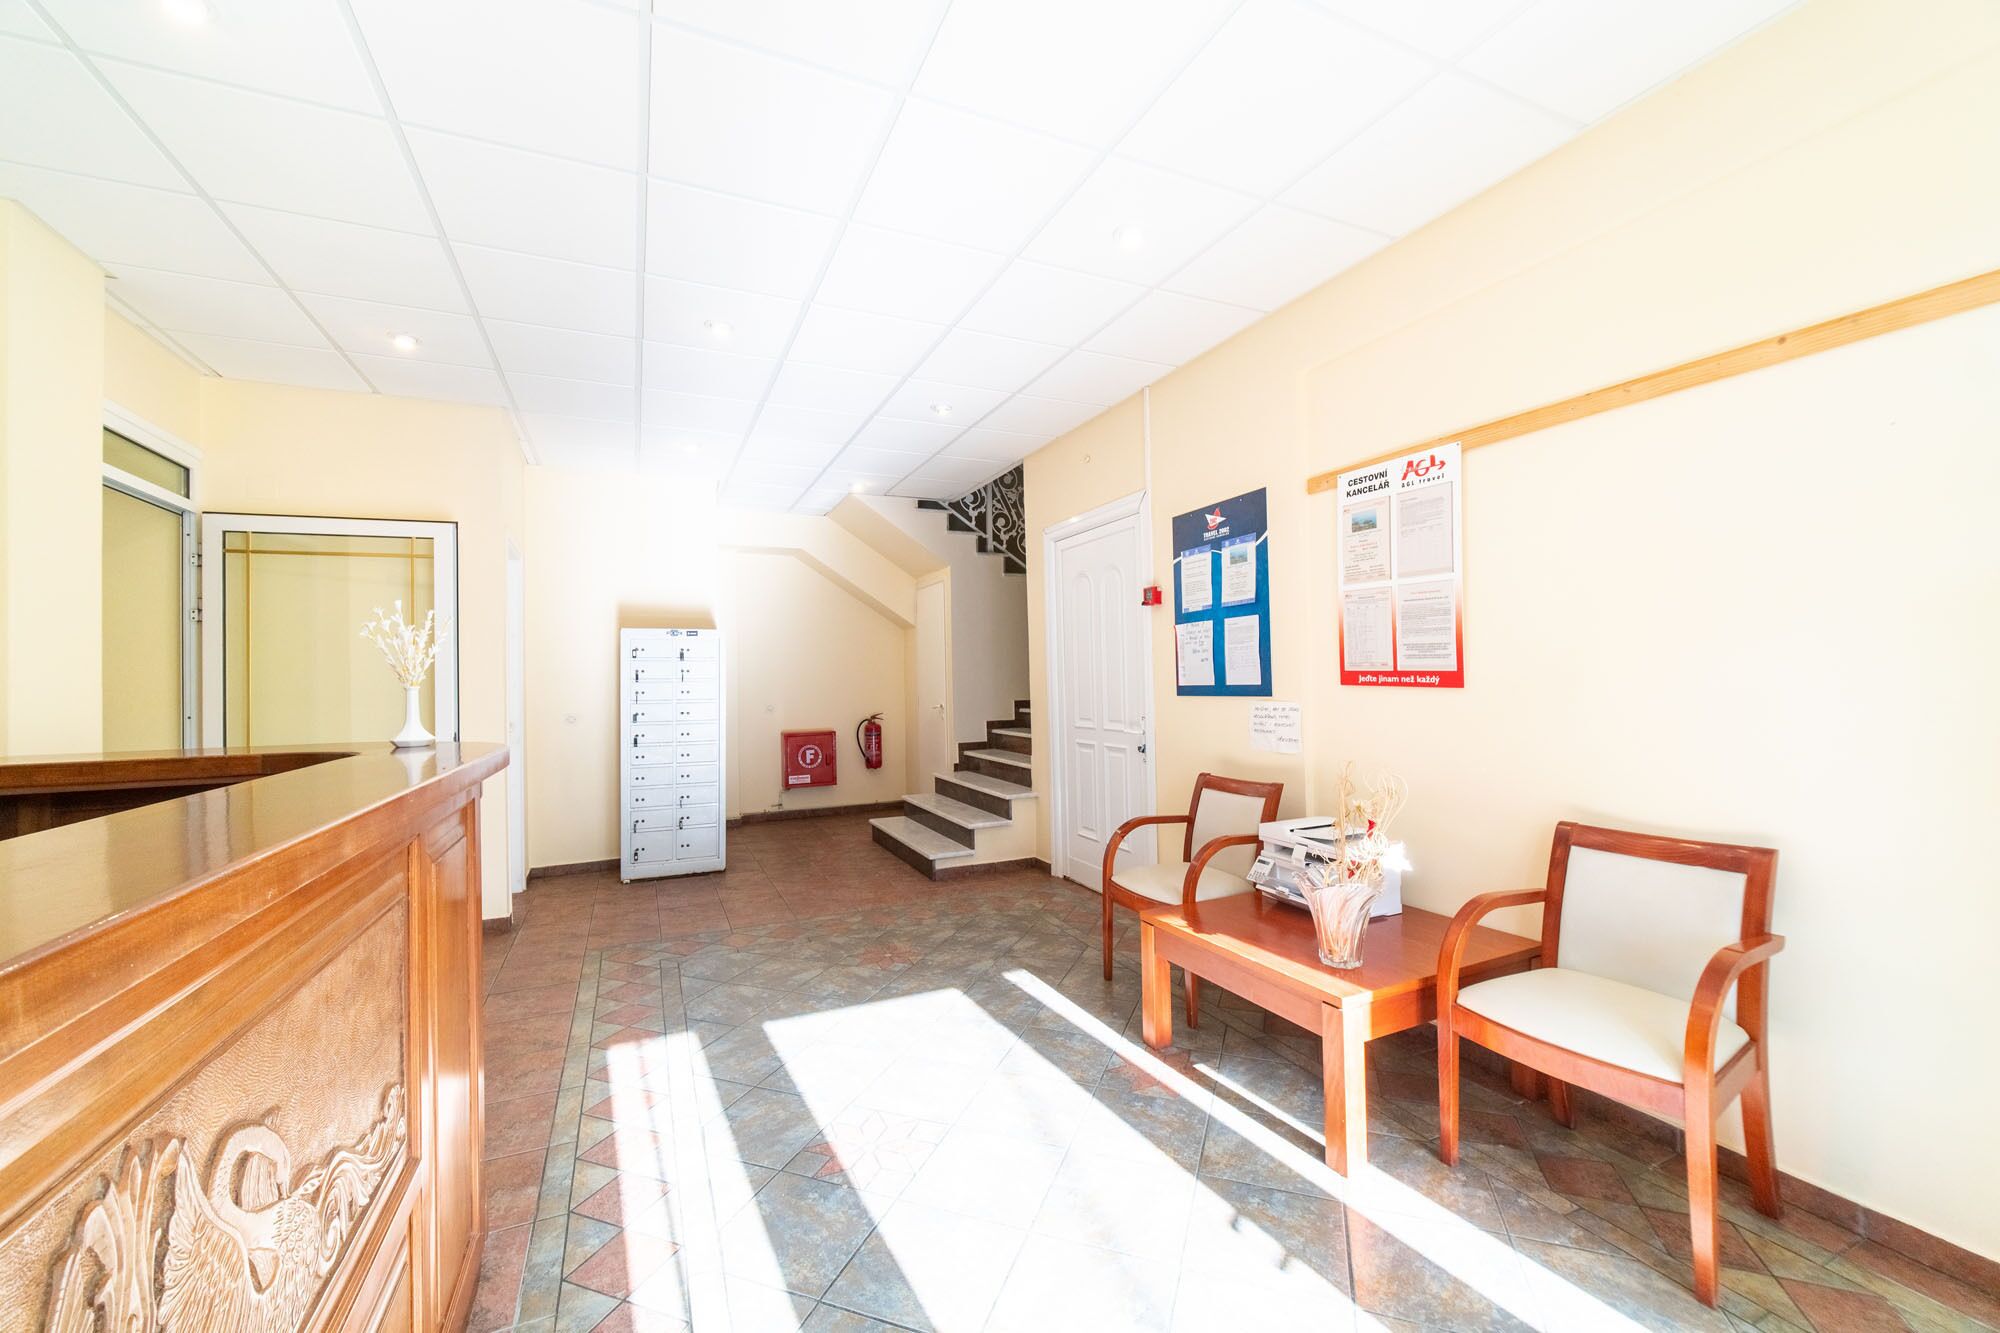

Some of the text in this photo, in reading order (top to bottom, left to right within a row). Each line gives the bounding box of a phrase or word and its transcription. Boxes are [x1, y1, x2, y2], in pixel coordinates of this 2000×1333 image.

[1401, 455, 1446, 481] AGL
[1348, 468, 1388, 487] CESTOVNÍ
[1419, 473, 1445, 484] travel
[1346, 480, 1390, 498] KANCELÁŘ
[1401, 675, 1416, 683] než
[1416, 675, 1440, 685] každý
[805, 749, 815, 764] F
